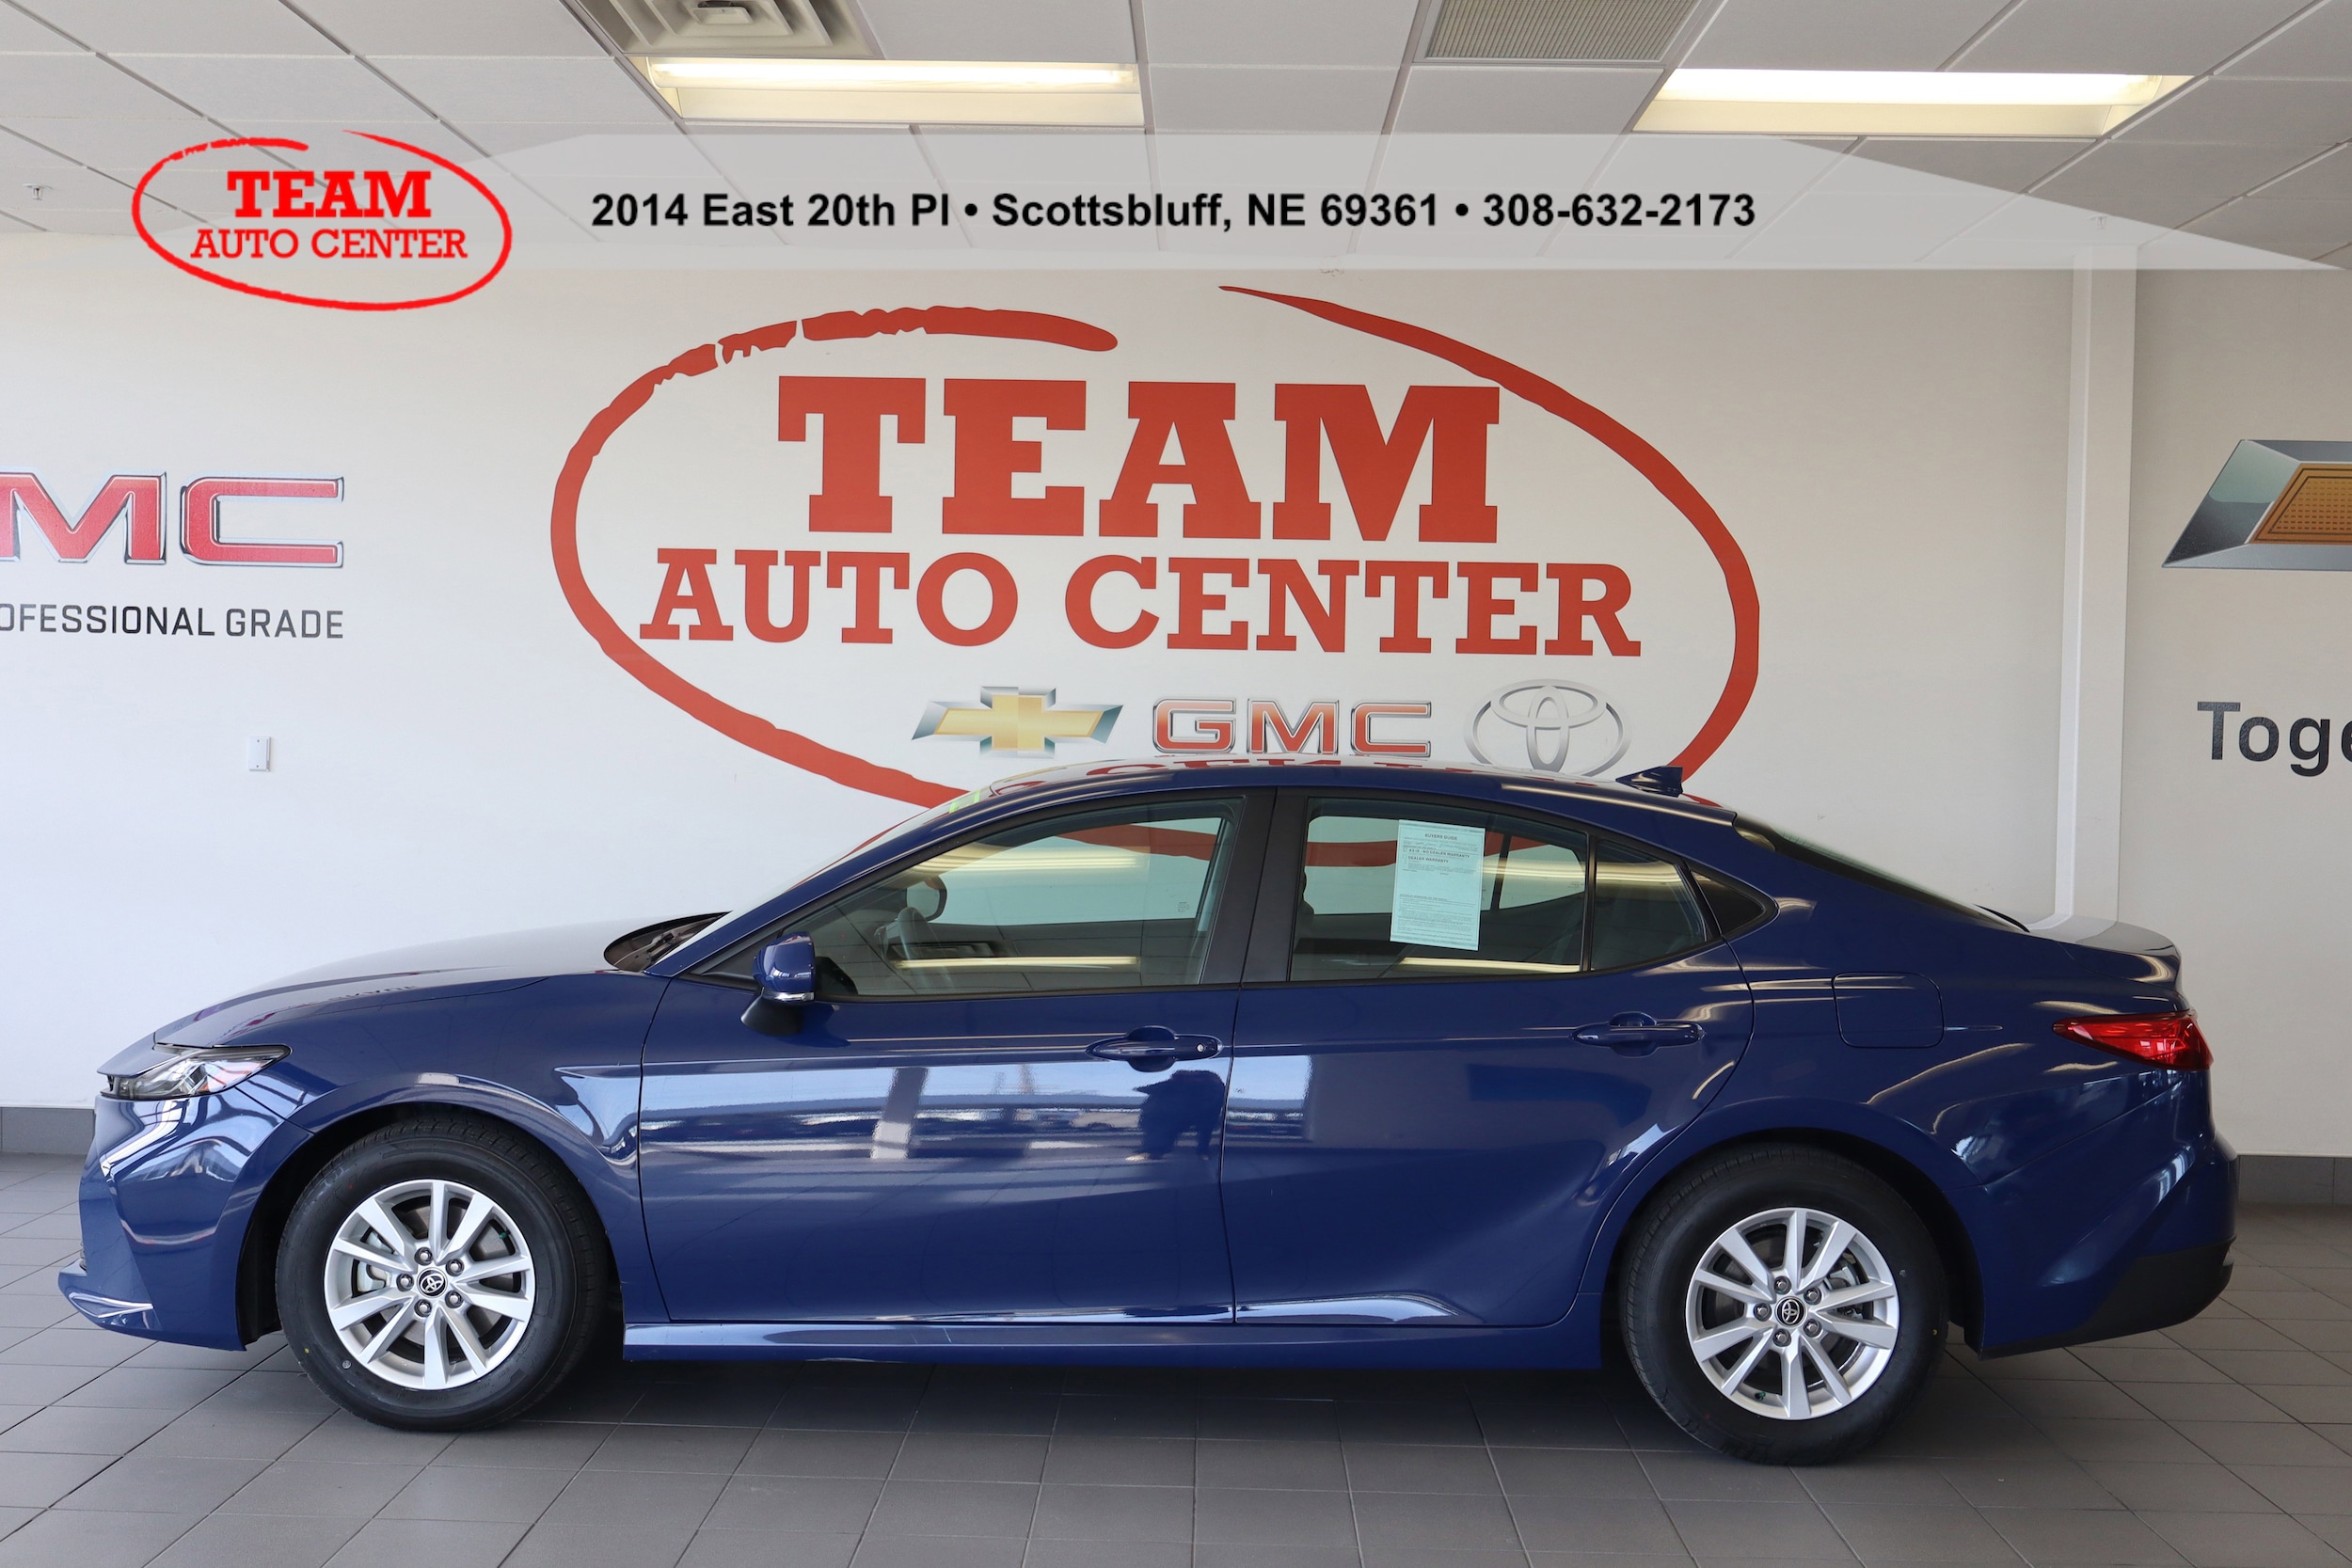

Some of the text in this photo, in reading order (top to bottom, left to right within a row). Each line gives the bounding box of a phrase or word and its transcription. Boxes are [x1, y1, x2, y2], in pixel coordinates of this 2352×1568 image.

[777, 375, 1501, 544] TEAM
[226, 609, 343, 639] GRADE
[641, 548, 1642, 657] AUTO CENTER
[1152, 698, 1432, 757] GMC
[2197, 701, 2352, 777] Tog
